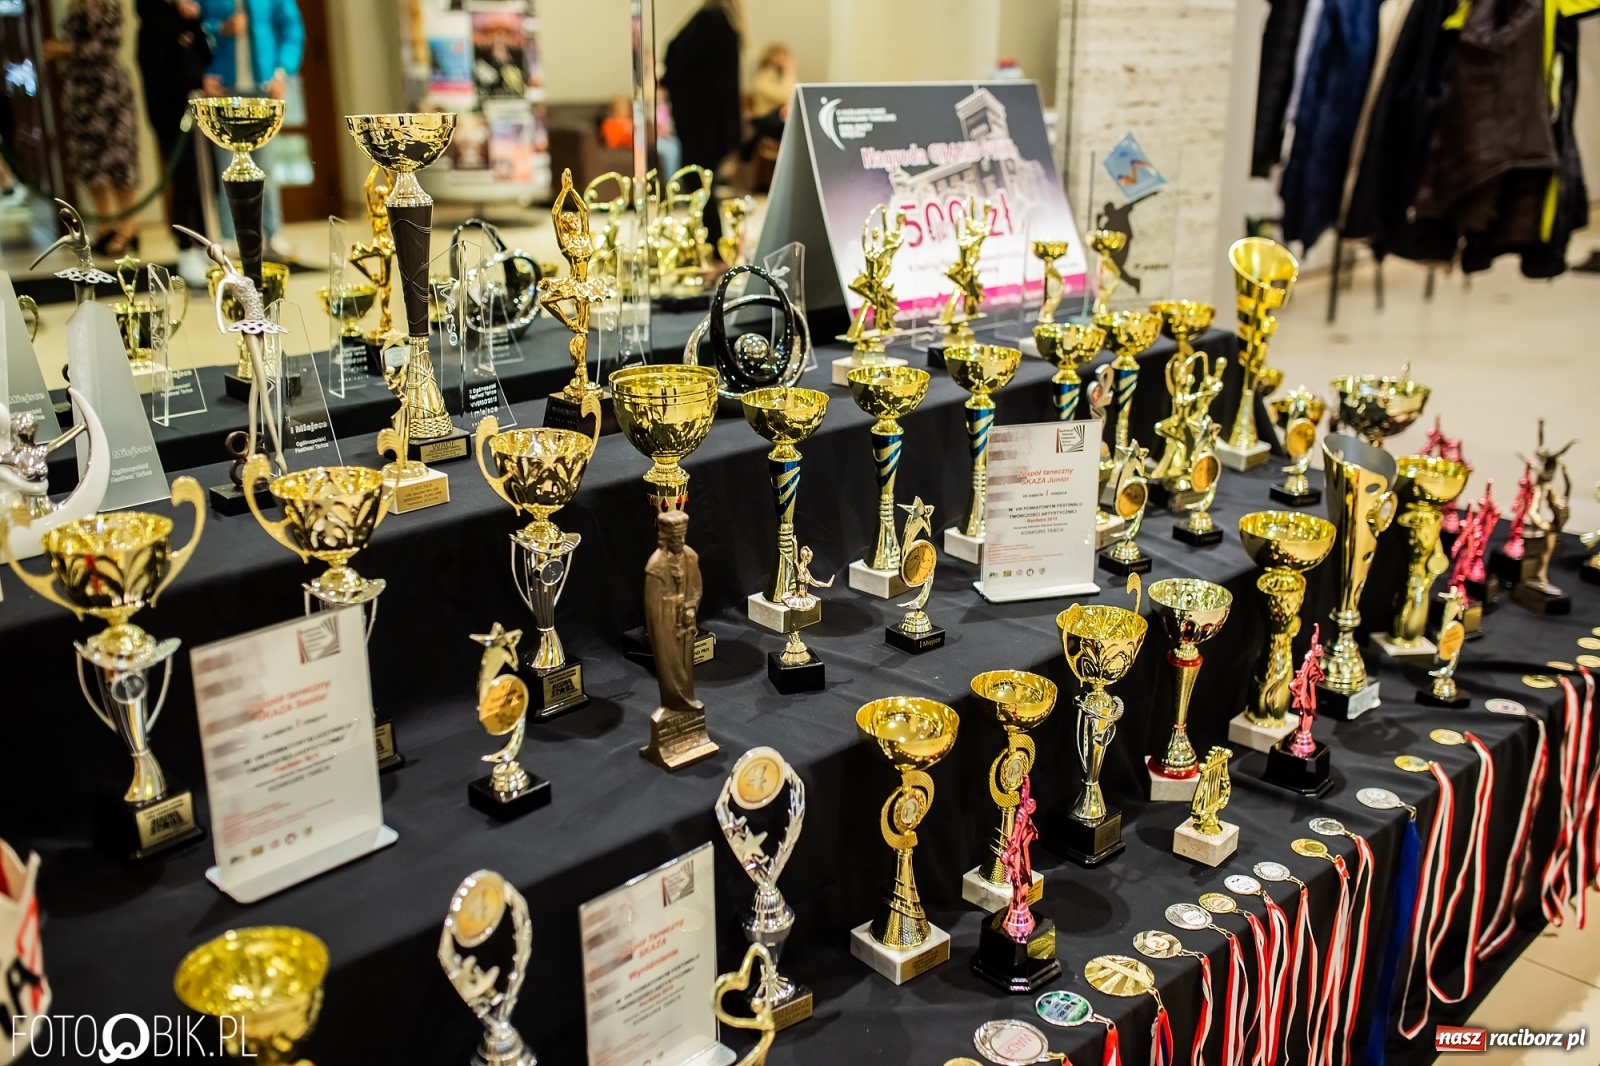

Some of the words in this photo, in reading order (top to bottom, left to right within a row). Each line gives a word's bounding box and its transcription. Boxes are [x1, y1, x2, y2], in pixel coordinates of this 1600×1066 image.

[295, 421, 328, 433] Miejsce
[1043, 468, 1073, 476] taneczny
[1021, 477, 1046, 485] SKAZA
[1047, 476, 1069, 484] Junior
